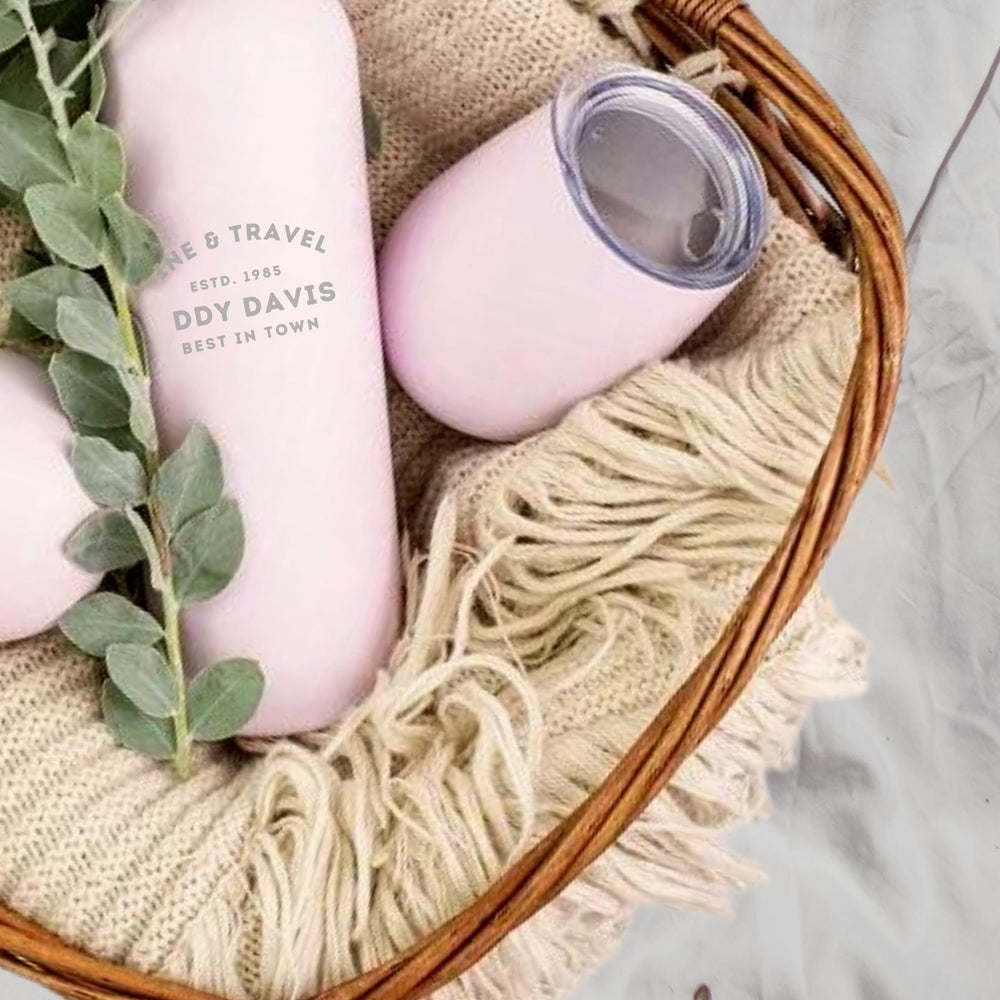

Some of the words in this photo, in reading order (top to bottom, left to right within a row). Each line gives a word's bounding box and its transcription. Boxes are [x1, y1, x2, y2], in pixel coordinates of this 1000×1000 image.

[204, 231, 219, 250] &
[228, 223, 326, 254] TRAVEL
[189, 275, 237, 293] ESTD.
[243, 265, 282, 283] 1985
[242, 281, 336, 318] DAVIS
[181, 335, 226, 355] BEST
[234, 329, 257, 345] IN
[263, 317, 320, 339] TOWN
